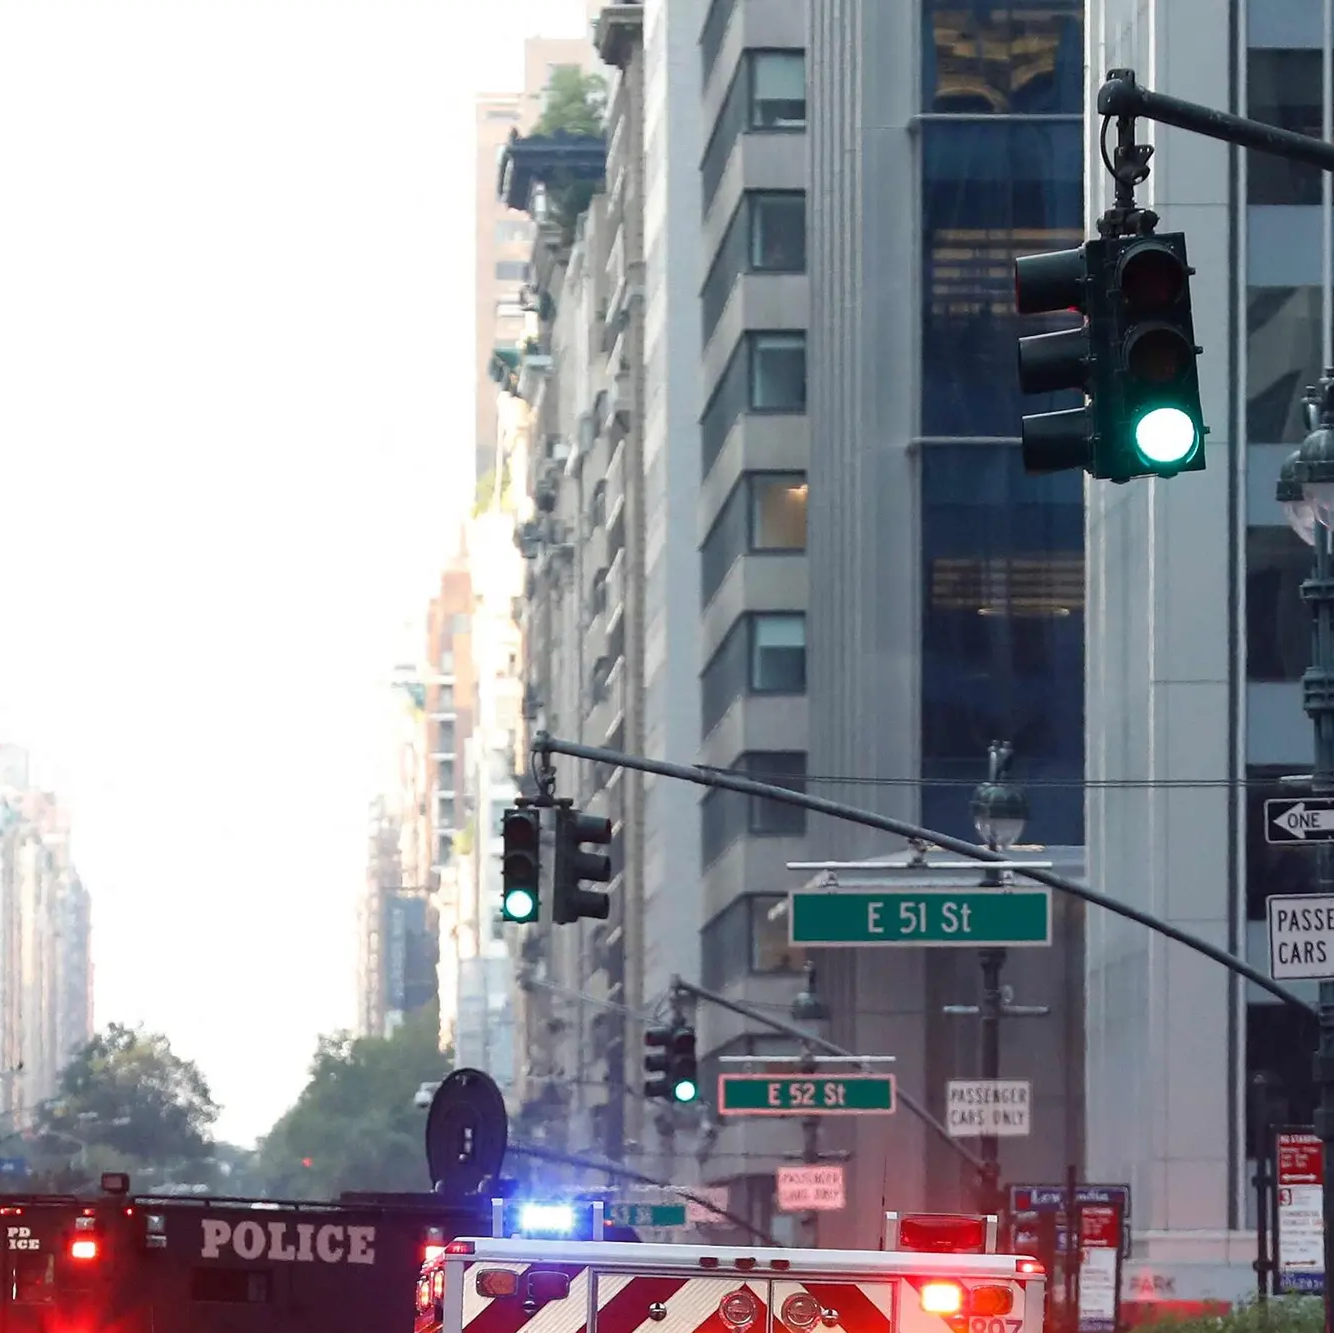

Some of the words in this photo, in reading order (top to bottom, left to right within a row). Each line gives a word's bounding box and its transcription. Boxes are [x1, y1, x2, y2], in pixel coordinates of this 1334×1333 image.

[1287, 812, 1321, 829] ONE
[868, 901, 884, 933] E
[900, 901, 926, 934] 51
[941, 901, 972, 933] St
[1279, 941, 1327, 964] CARS
[768, 1083, 781, 1106] E
[789, 1082, 816, 1106] 52
[824, 1083, 846, 1106] St
[201, 1219, 376, 1265] POLICE
